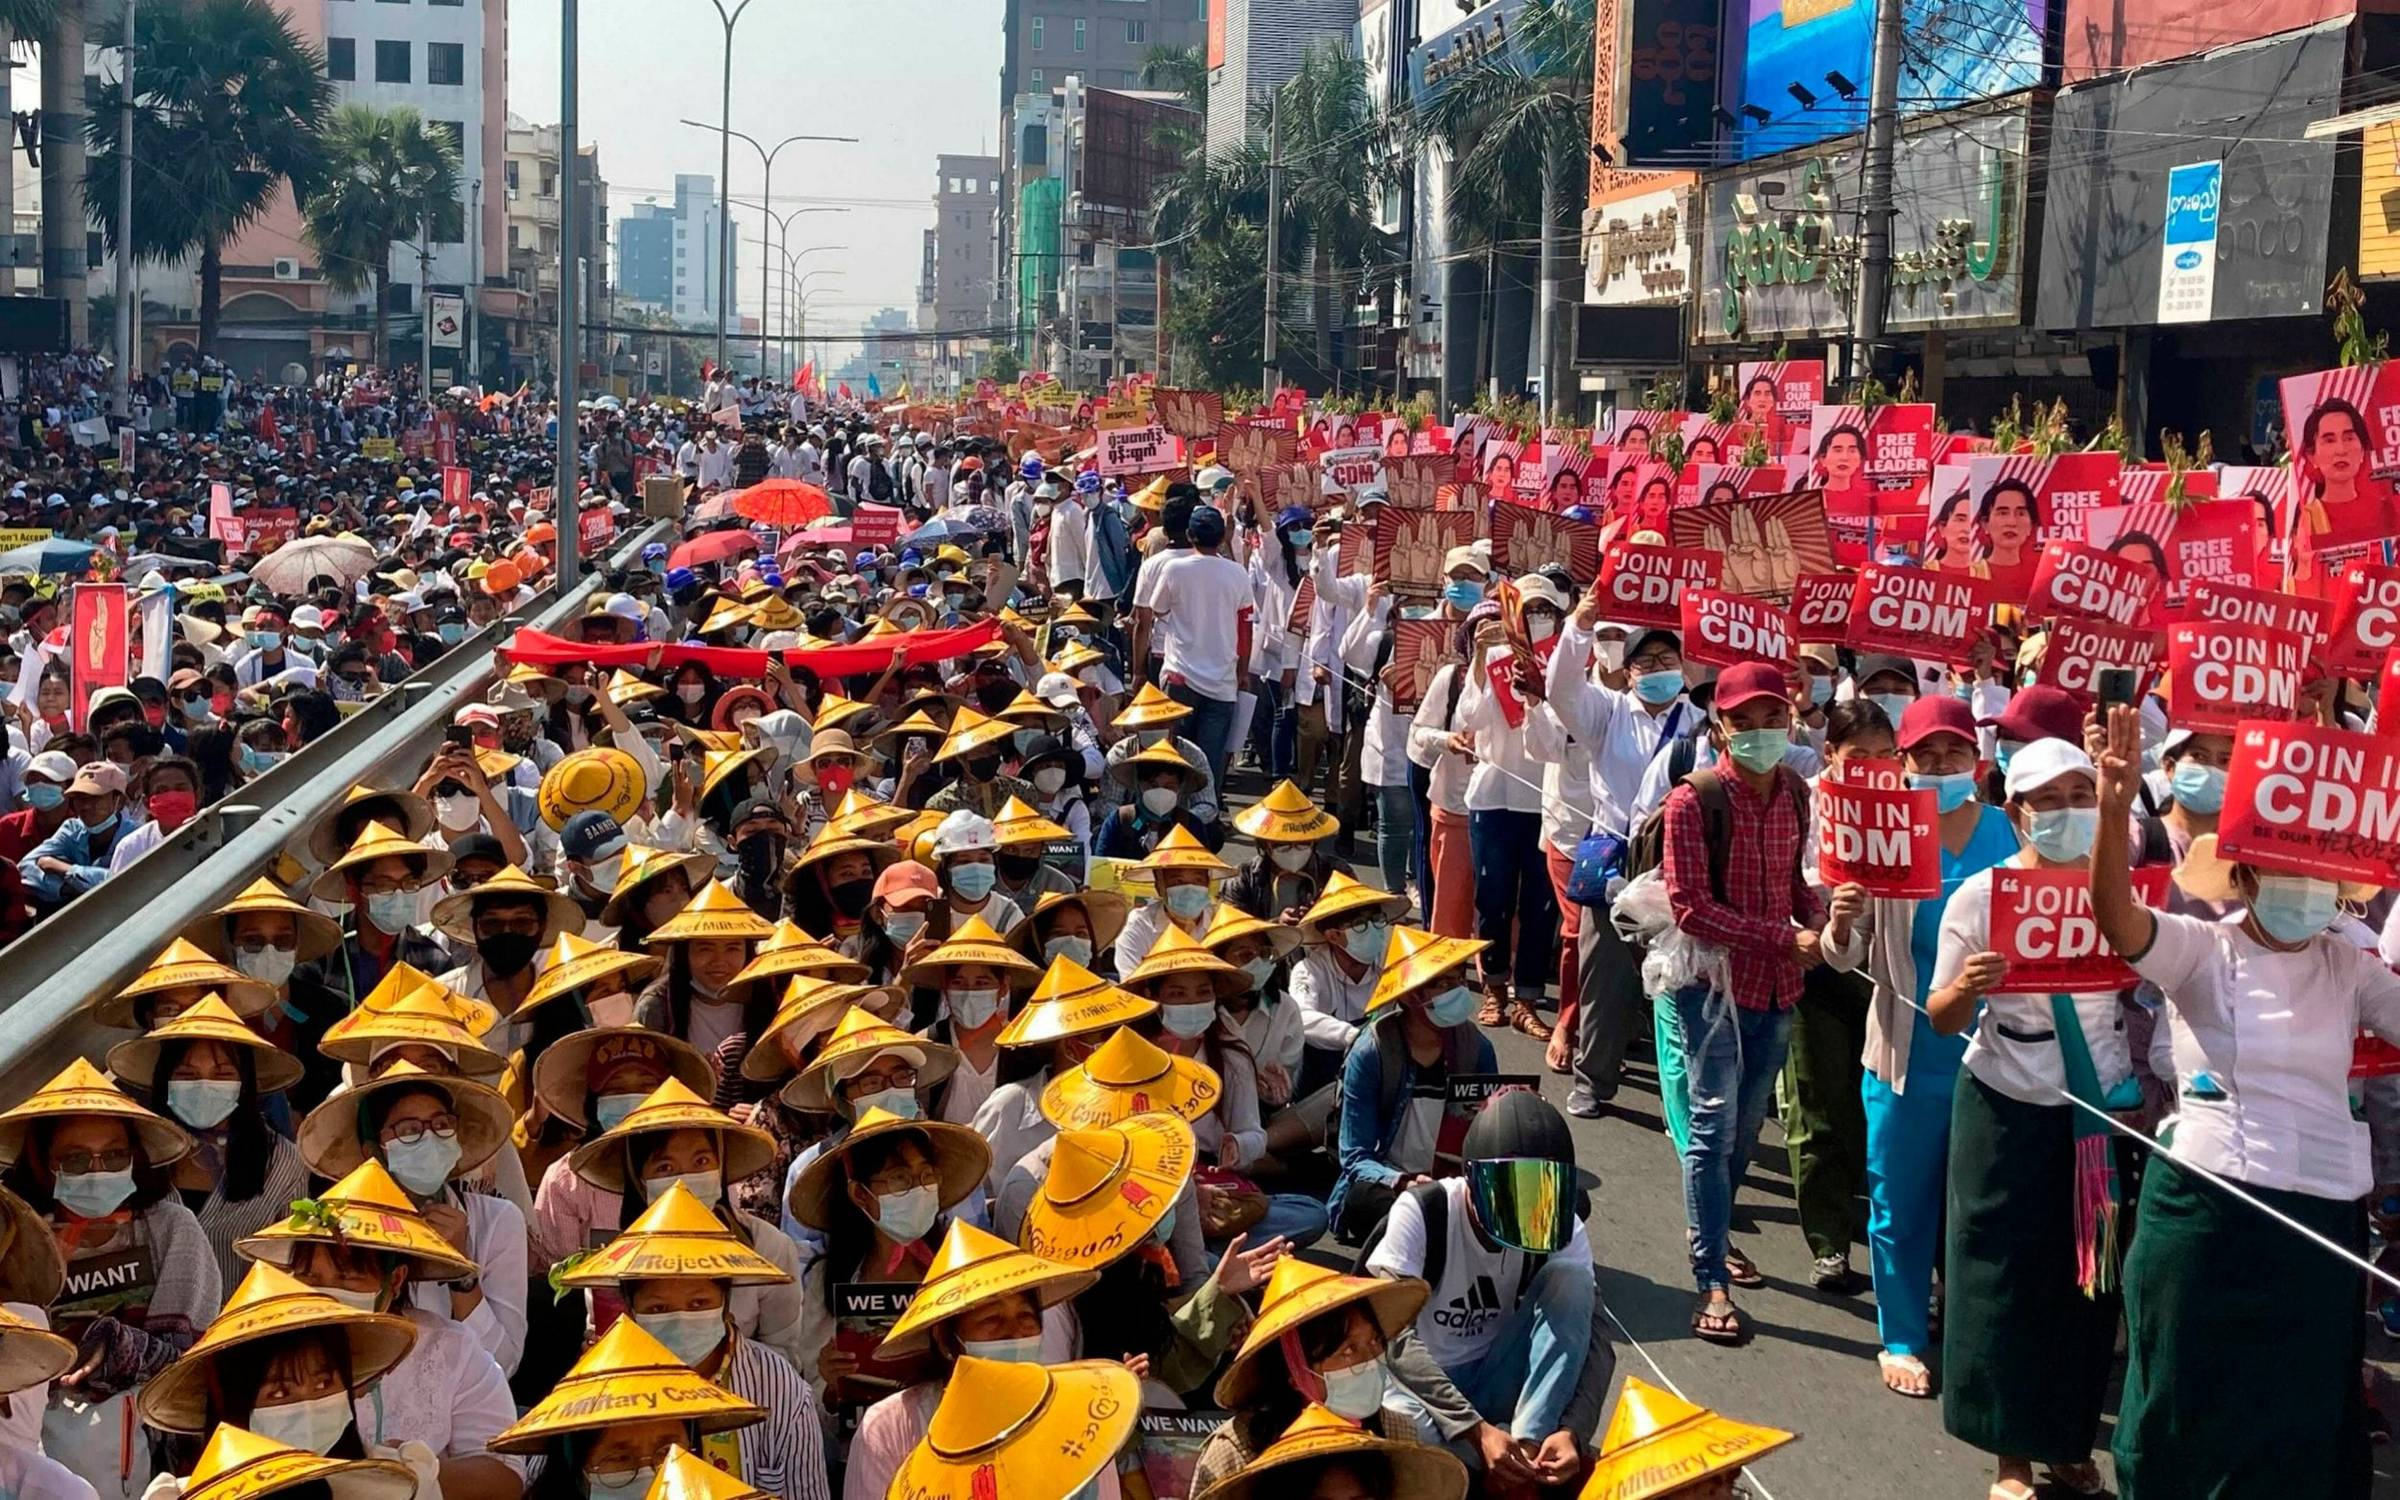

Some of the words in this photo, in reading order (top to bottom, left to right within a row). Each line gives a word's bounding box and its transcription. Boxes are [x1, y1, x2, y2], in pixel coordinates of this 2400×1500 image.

[1784, 381, 1812, 392] FREE
[1785, 391, 1811, 401] OUR
[1877, 433, 1917, 447] FREE
[1878, 446, 1914, 460] OUR
[1334, 464, 1375, 486] CDM
[1520, 471, 1541, 480] OUR
[1864, 458, 1928, 473] LEADER
[2051, 491, 2102, 508] FREE
[2053, 508, 2084, 526] OU
[2179, 538, 2233, 560] FREE
[1682, 558, 1706, 578] IN
[2182, 556, 2233, 578] OUR
[2124, 571, 2146, 597] IN
[1945, 584, 1972, 608] IN
[1800, 599, 1850, 625] CD
[2286, 608, 2319, 635] IN
[1764, 611, 1785, 635] IN
[2130, 641, 2154, 664] IN
[2277, 642, 2297, 671] IN
[1875, 802, 1910, 828] IN
[2253, 825, 2273, 838] BE
[2278, 830, 2312, 845] OUR
[1048, 845, 1079, 854] WANT
[1454, 1083, 1479, 1097] WE
[633, 1254, 721, 1272] #Reject
[67, 1261, 140, 1295] WANT
[847, 1294, 884, 1310] WE
[559, 1390, 657, 1418] Military
[662, 1385, 721, 1405] Coup
[1141, 1415, 1174, 1431] WE
[1617, 1452, 1708, 1498] Military
